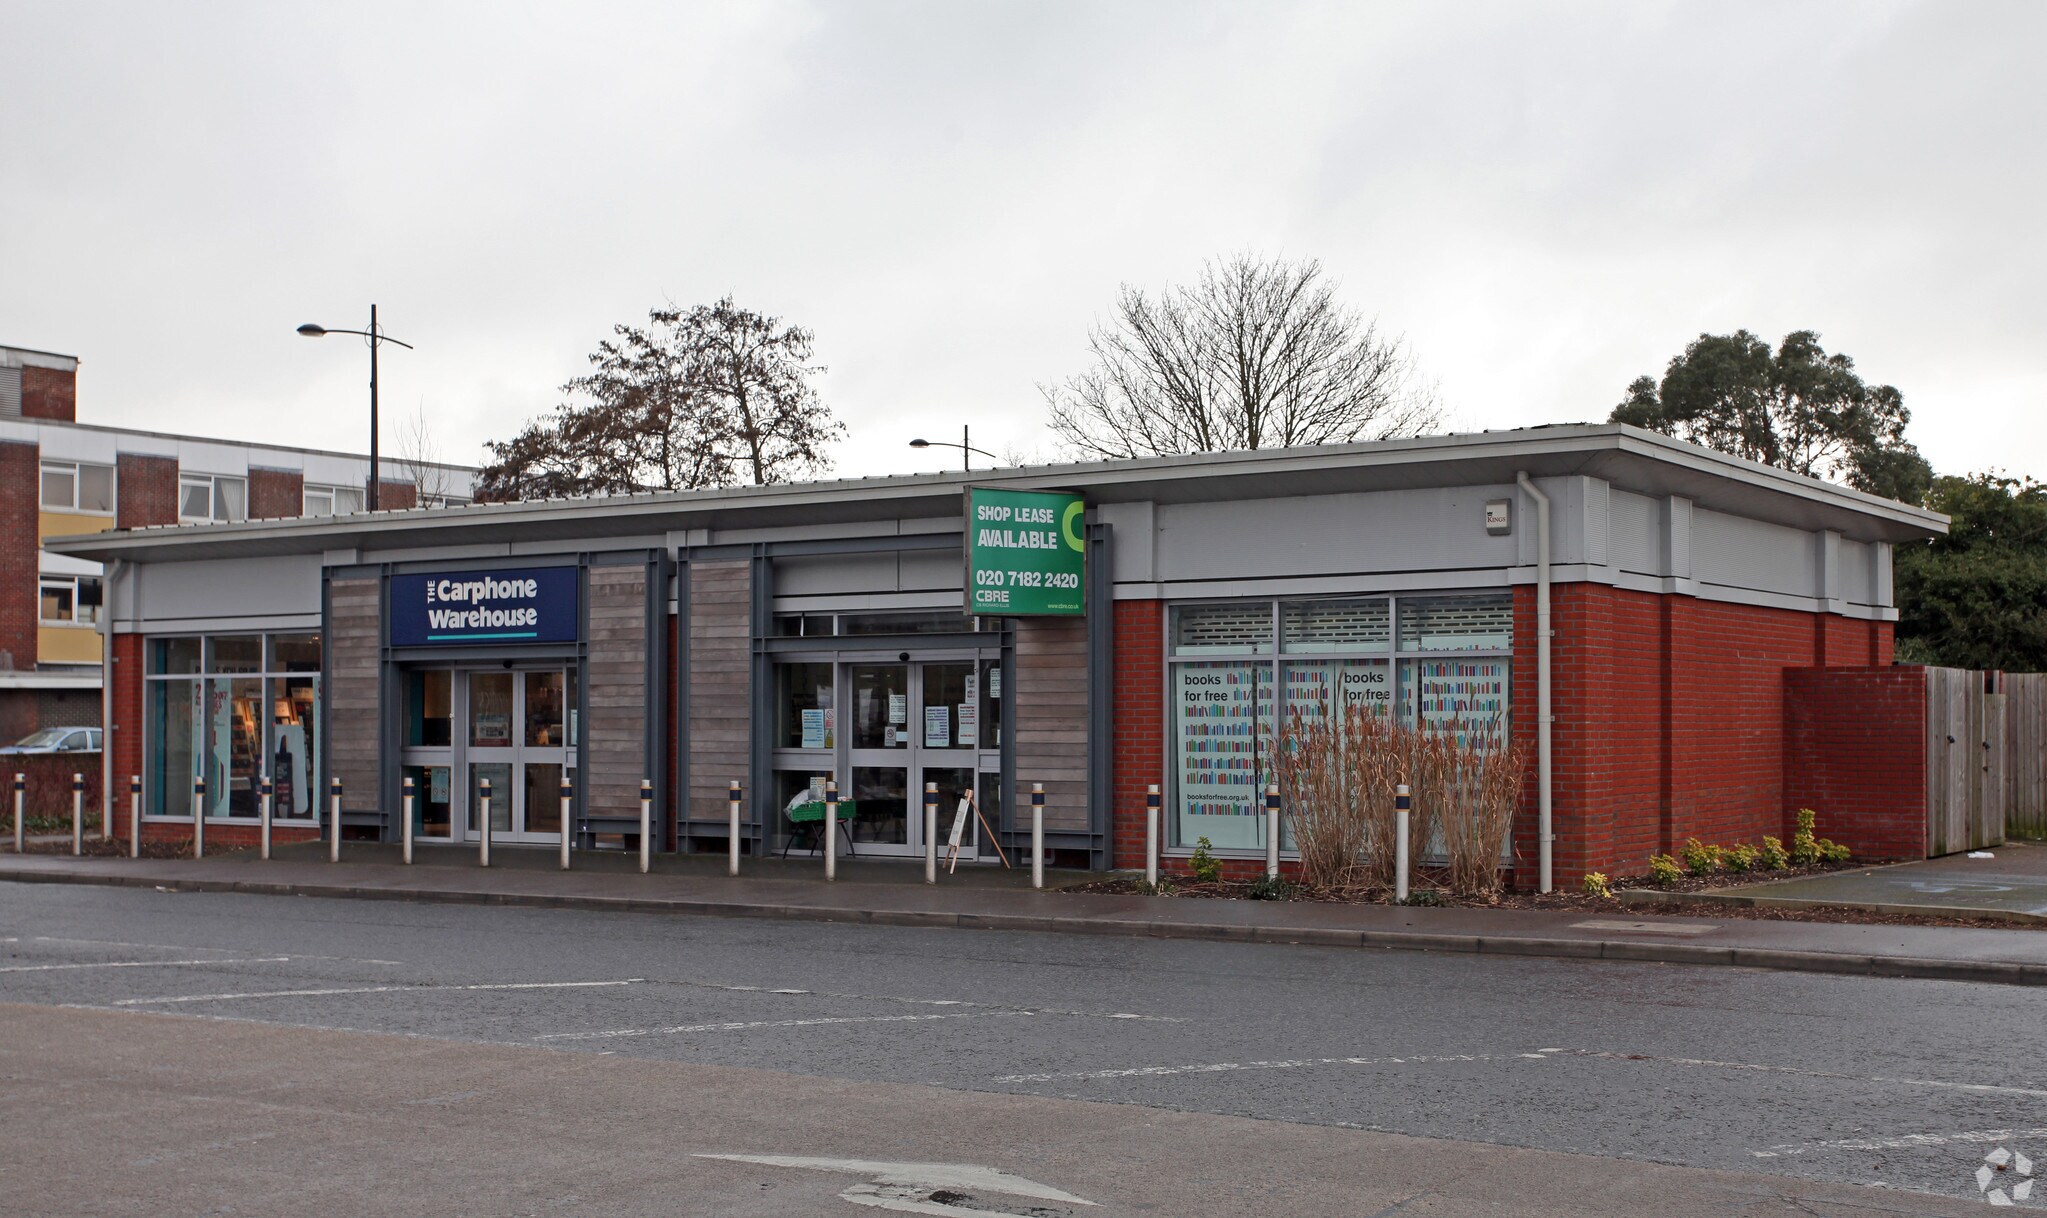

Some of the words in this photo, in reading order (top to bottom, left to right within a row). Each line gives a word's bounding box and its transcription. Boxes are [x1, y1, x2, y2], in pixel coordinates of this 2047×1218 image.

[978, 506, 1010, 521] SHOP
[1015, 508, 1054, 523] LEASE
[978, 529, 1057, 549] AVAILABLE
[976, 570, 1004, 586] 020
[1008, 571, 1042, 587] 7182
[1045, 573, 1079, 589] 2420
[427, 580, 436, 604] THE
[437, 576, 538, 605] Carphone
[976, 590, 1009, 602] CBRE
[428, 606, 538, 629] Warehouse
[1184, 674, 1221, 685] books
[1344, 672, 1384, 683] books
[1184, 690, 1201, 701] for
[1204, 690, 1228, 701] free
[1366, 688, 1390, 700] free
[1187, 793, 1250, 802] booksforfree.org.uk
